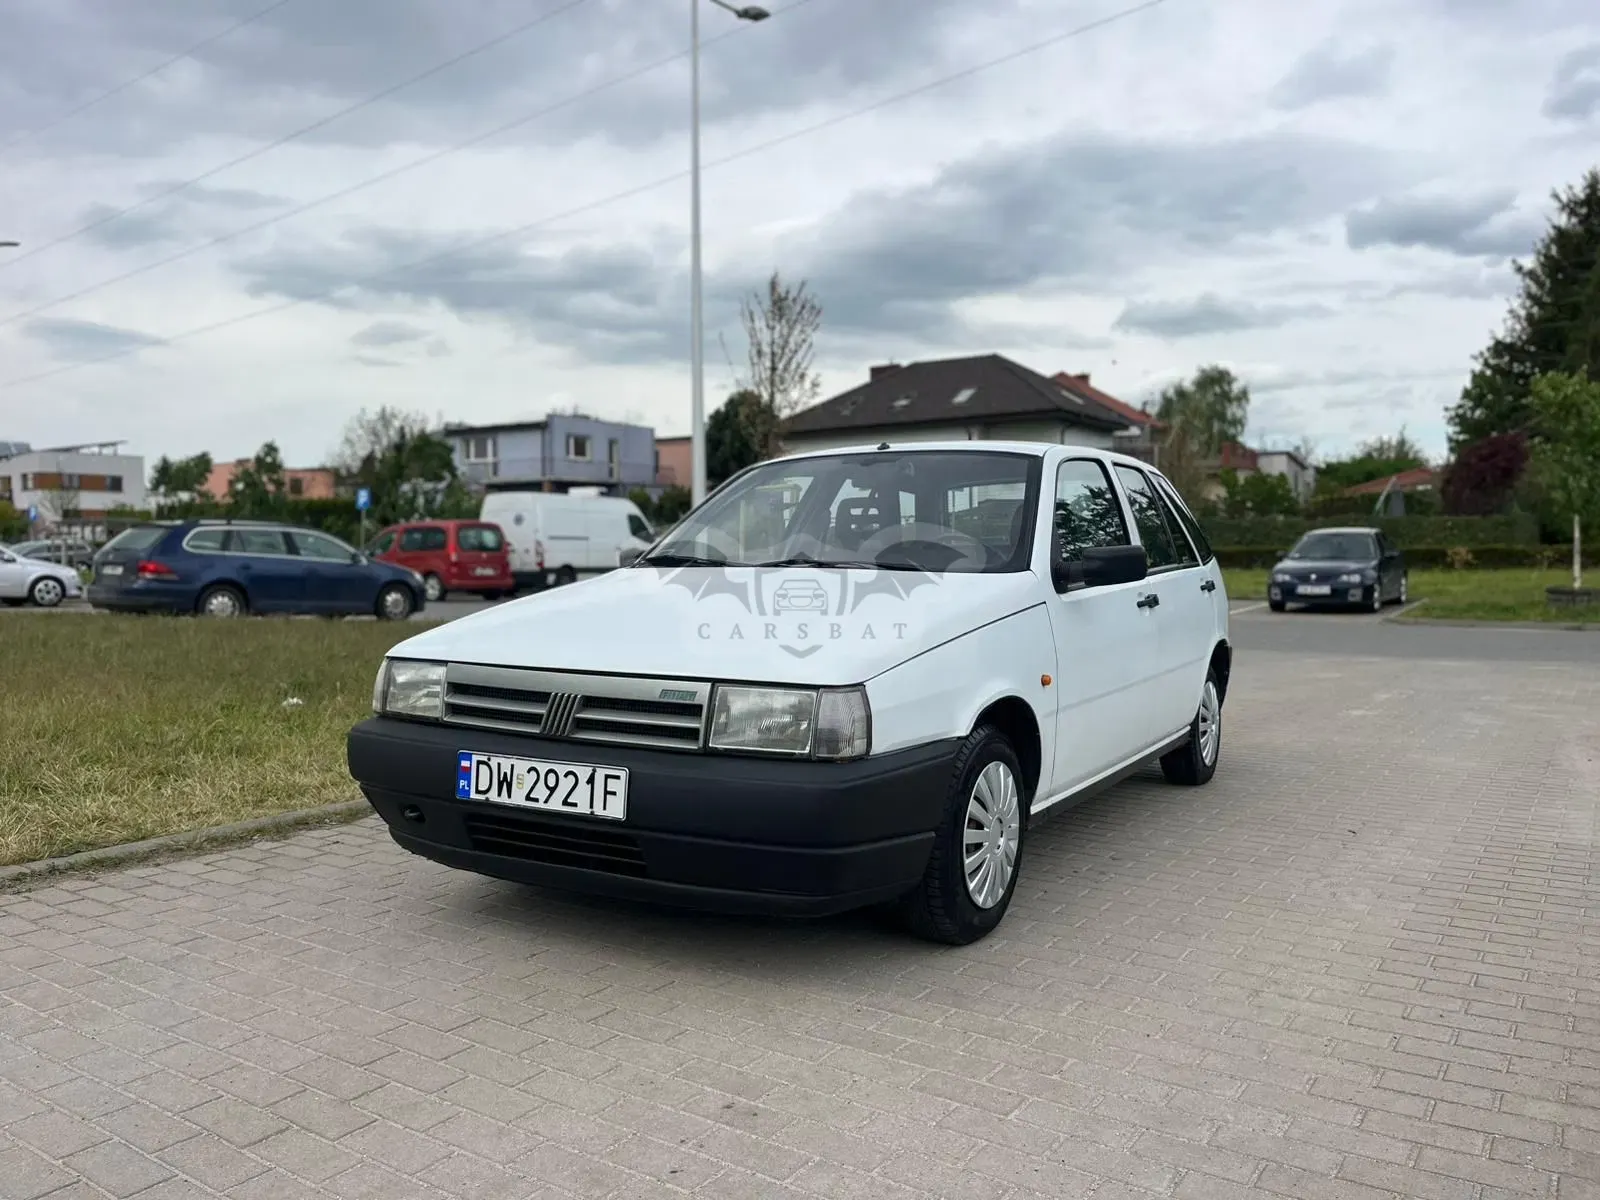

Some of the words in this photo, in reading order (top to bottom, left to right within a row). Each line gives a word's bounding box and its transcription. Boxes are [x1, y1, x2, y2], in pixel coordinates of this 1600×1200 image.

[459, 780, 470, 790] PL
[474, 760, 515, 799] DW
[525, 766, 621, 811] 2921F
